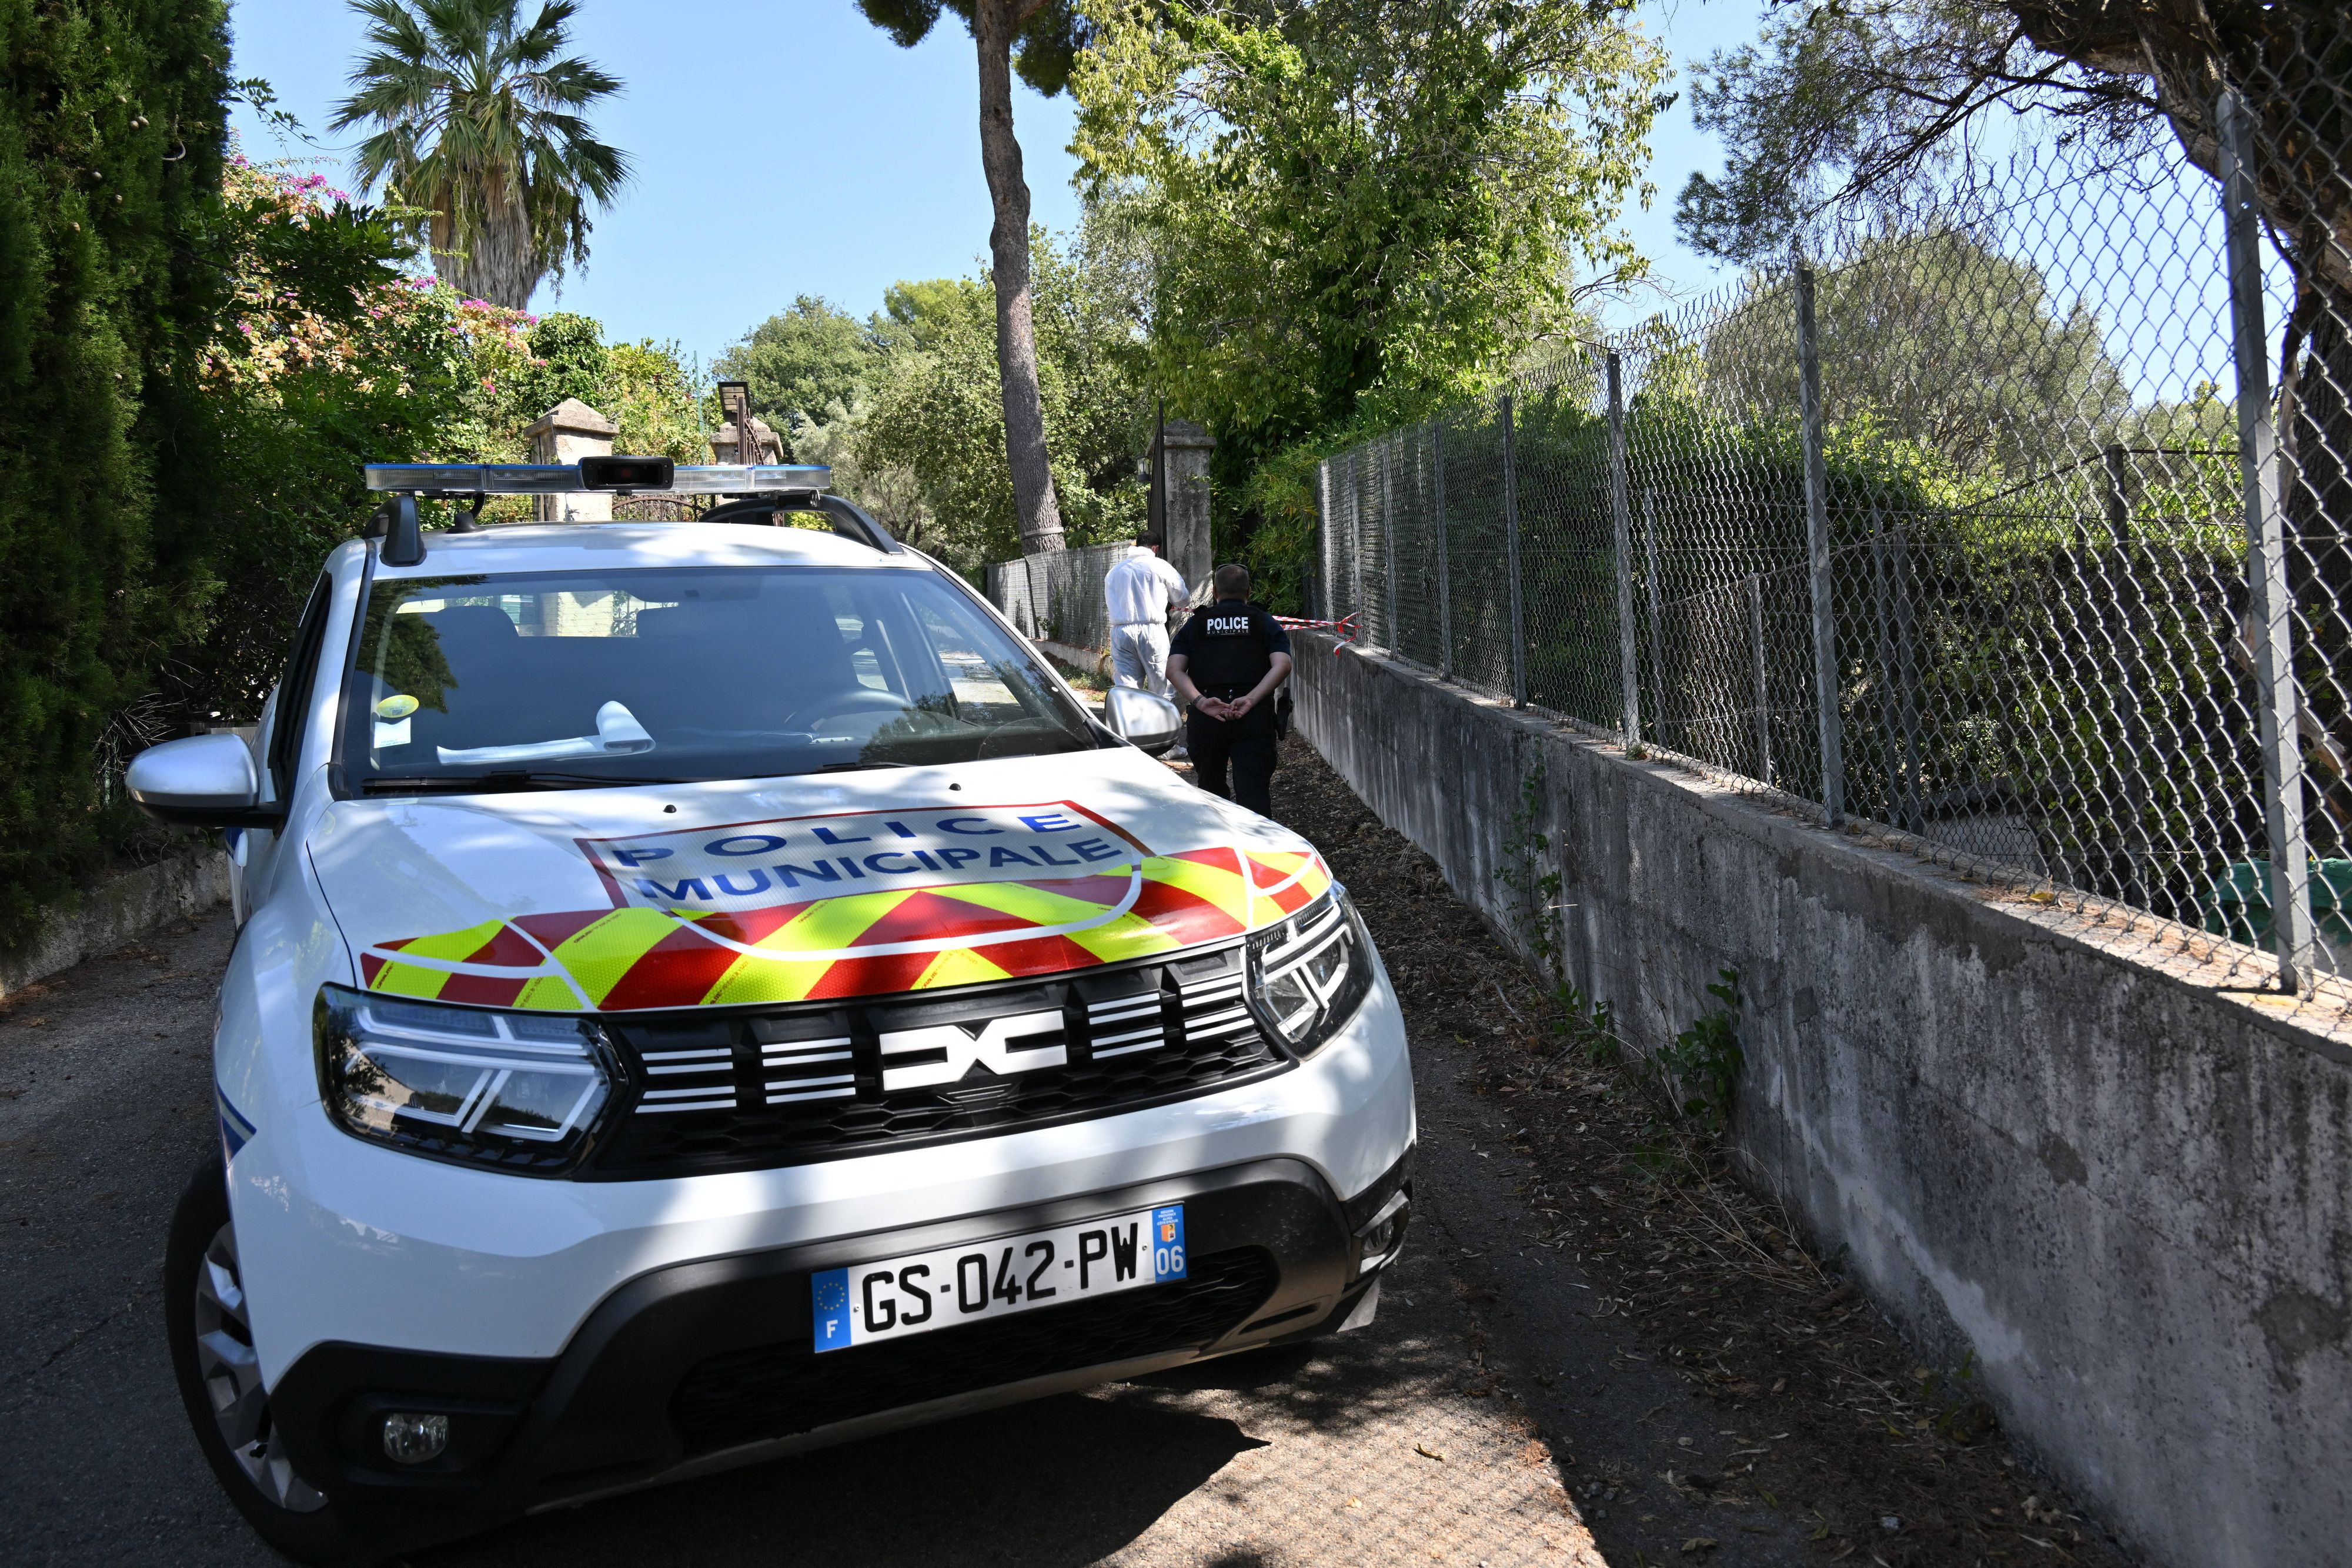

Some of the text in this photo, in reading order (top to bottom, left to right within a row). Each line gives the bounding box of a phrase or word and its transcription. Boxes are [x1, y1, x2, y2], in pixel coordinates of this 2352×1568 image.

[1207, 617, 1248, 631] POLICE
[611, 813, 1082, 867] POLICE
[632, 838, 1123, 901] MUNICIPALE
[862, 1222, 1139, 1333] GS-042-PW
[1156, 1245, 1184, 1275] 06
[827, 1320, 838, 1338] F
